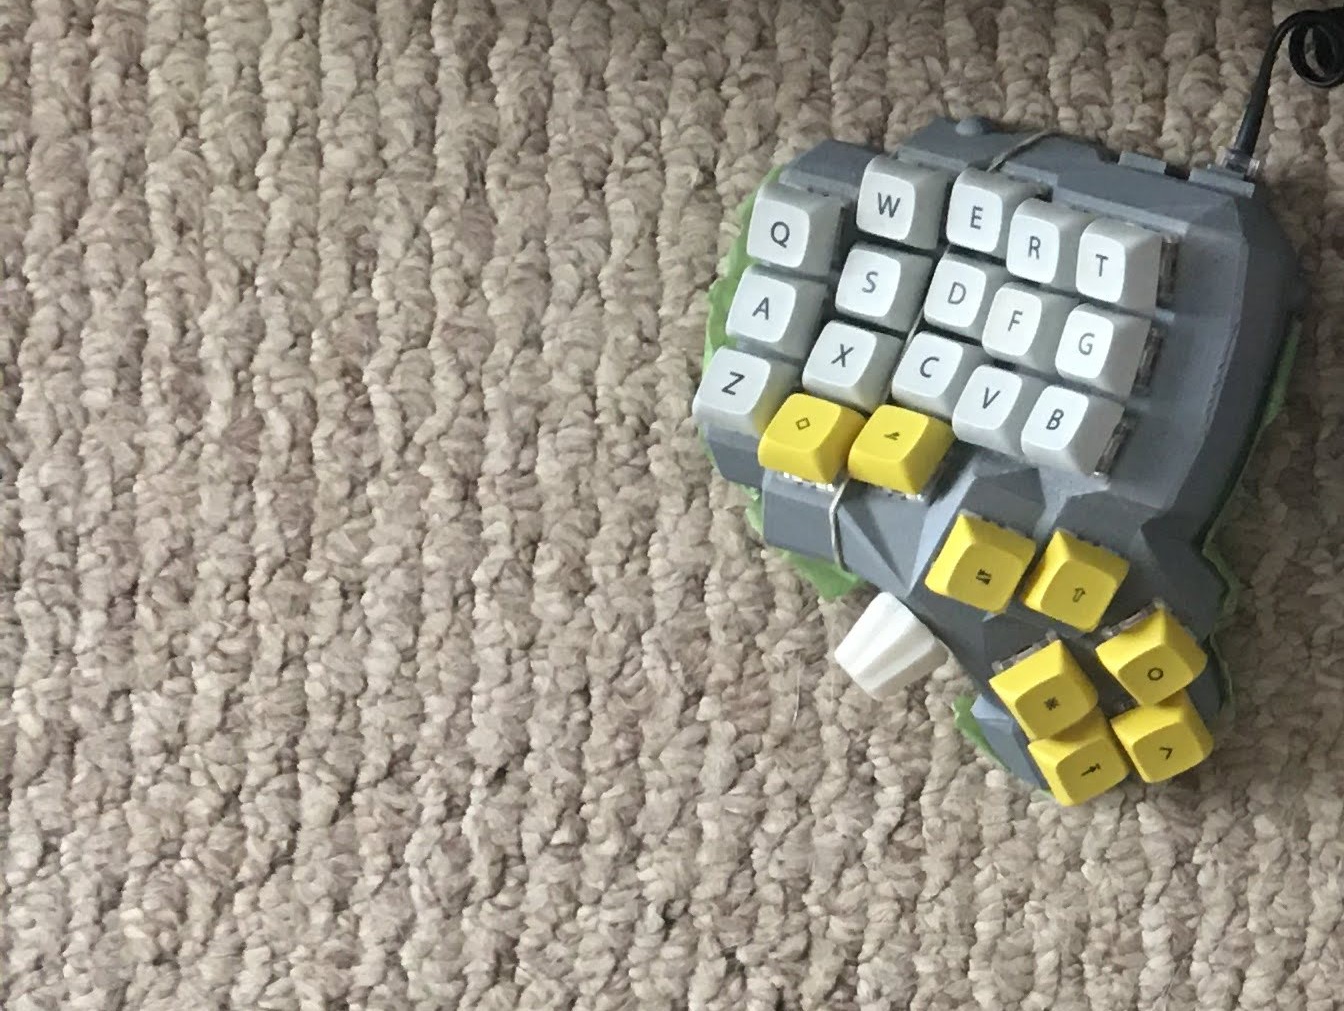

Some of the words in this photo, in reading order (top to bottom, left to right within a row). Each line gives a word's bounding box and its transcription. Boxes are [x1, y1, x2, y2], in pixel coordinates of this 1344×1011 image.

[770, 221, 791, 249] Q
[877, 192, 901, 219] W
[969, 205, 984, 230] E
[1027, 235, 1042, 260] R
[1095, 253, 1109, 278] T
[751, 296, 770, 321] A
[861, 270, 879, 294] S
[947, 281, 967, 305] D
[1007, 309, 1024, 332] F
[1078, 332, 1095, 356] G
[721, 371, 746, 396] Z
[830, 343, 854, 368] X
[919, 356, 940, 379] C
[982, 386, 1001, 410] V
[1045, 408, 1065, 431] B
